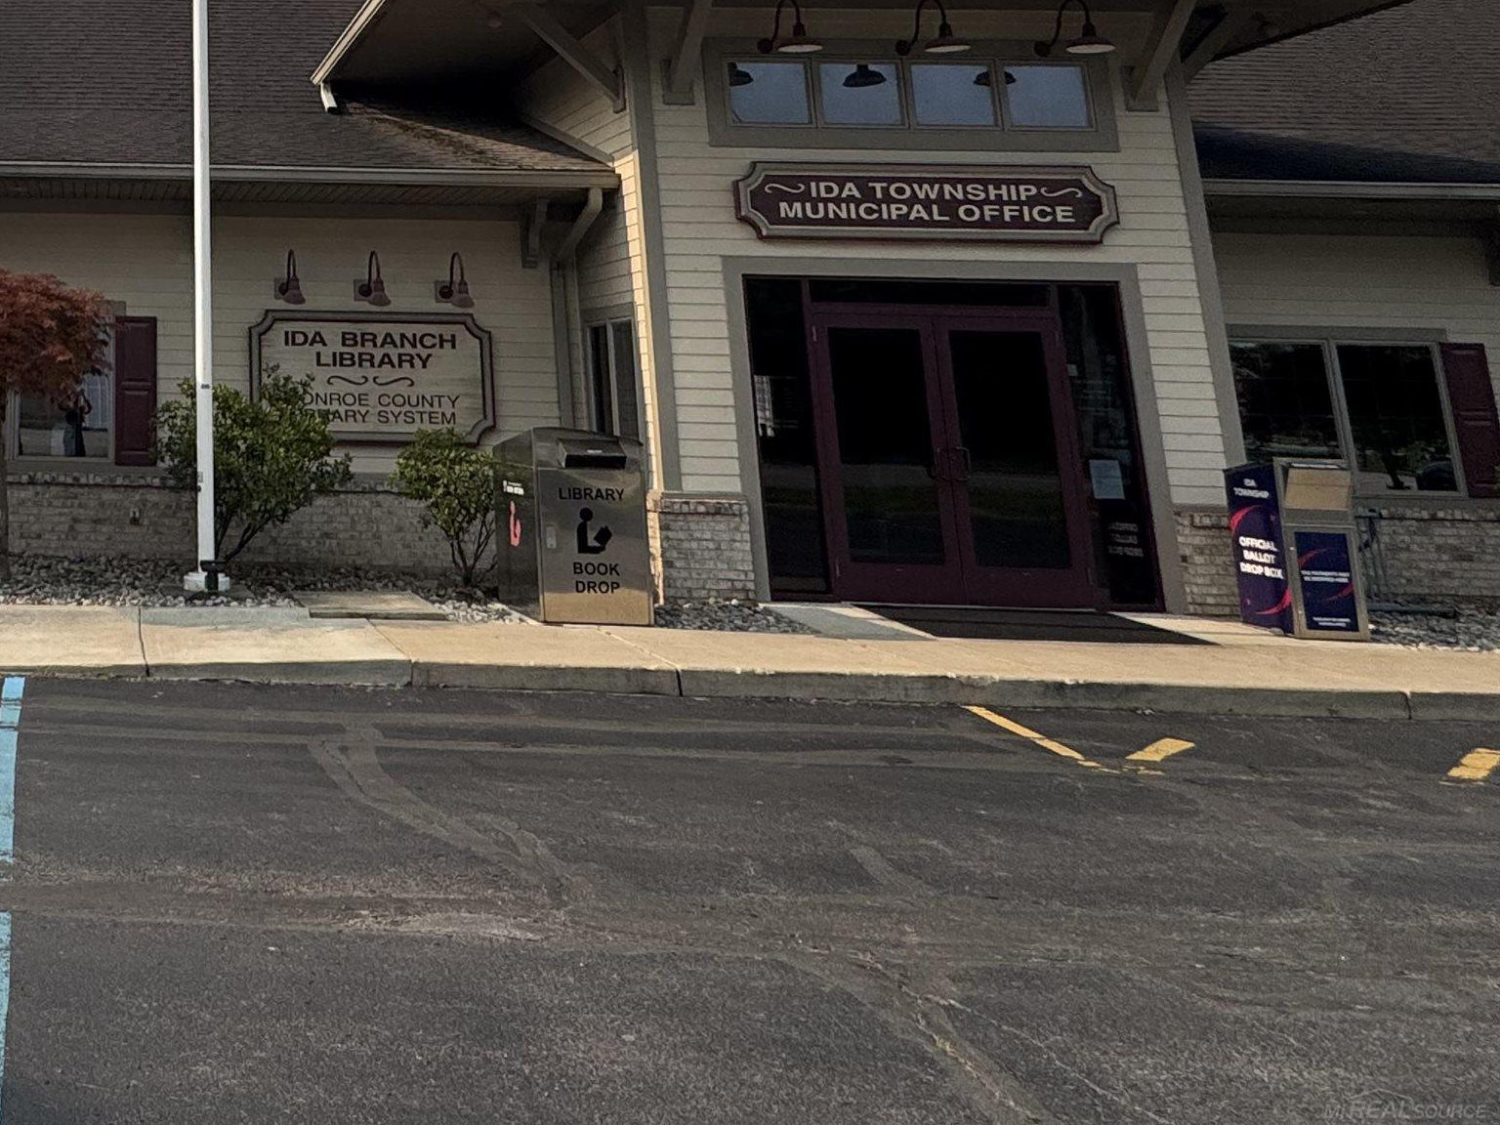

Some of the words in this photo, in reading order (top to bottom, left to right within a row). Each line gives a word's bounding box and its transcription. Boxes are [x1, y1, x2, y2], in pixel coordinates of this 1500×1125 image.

[809, 181, 862, 199] IDA
[868, 182, 1038, 201] TOWNSHIP
[779, 201, 950, 221] MUNICIPAL
[957, 205, 1075, 223] OFFICE
[284, 330, 328, 347] IDA
[341, 331, 457, 350] BRANCH
[315, 351, 433, 369] LIBRARY
[303, 392, 369, 406] ONROE
[378, 393, 460, 409] COUNTY
[377, 410, 457, 425] SYSTEM
[558, 487, 624, 501] LIBRARY
[1238, 536, 1279, 552] OFFICIAL
[1242, 549, 1276, 564] BALLOT
[573, 562, 620, 577] BOOK
[1239, 562, 1264, 575] DROP
[575, 580, 620, 594] DROP
